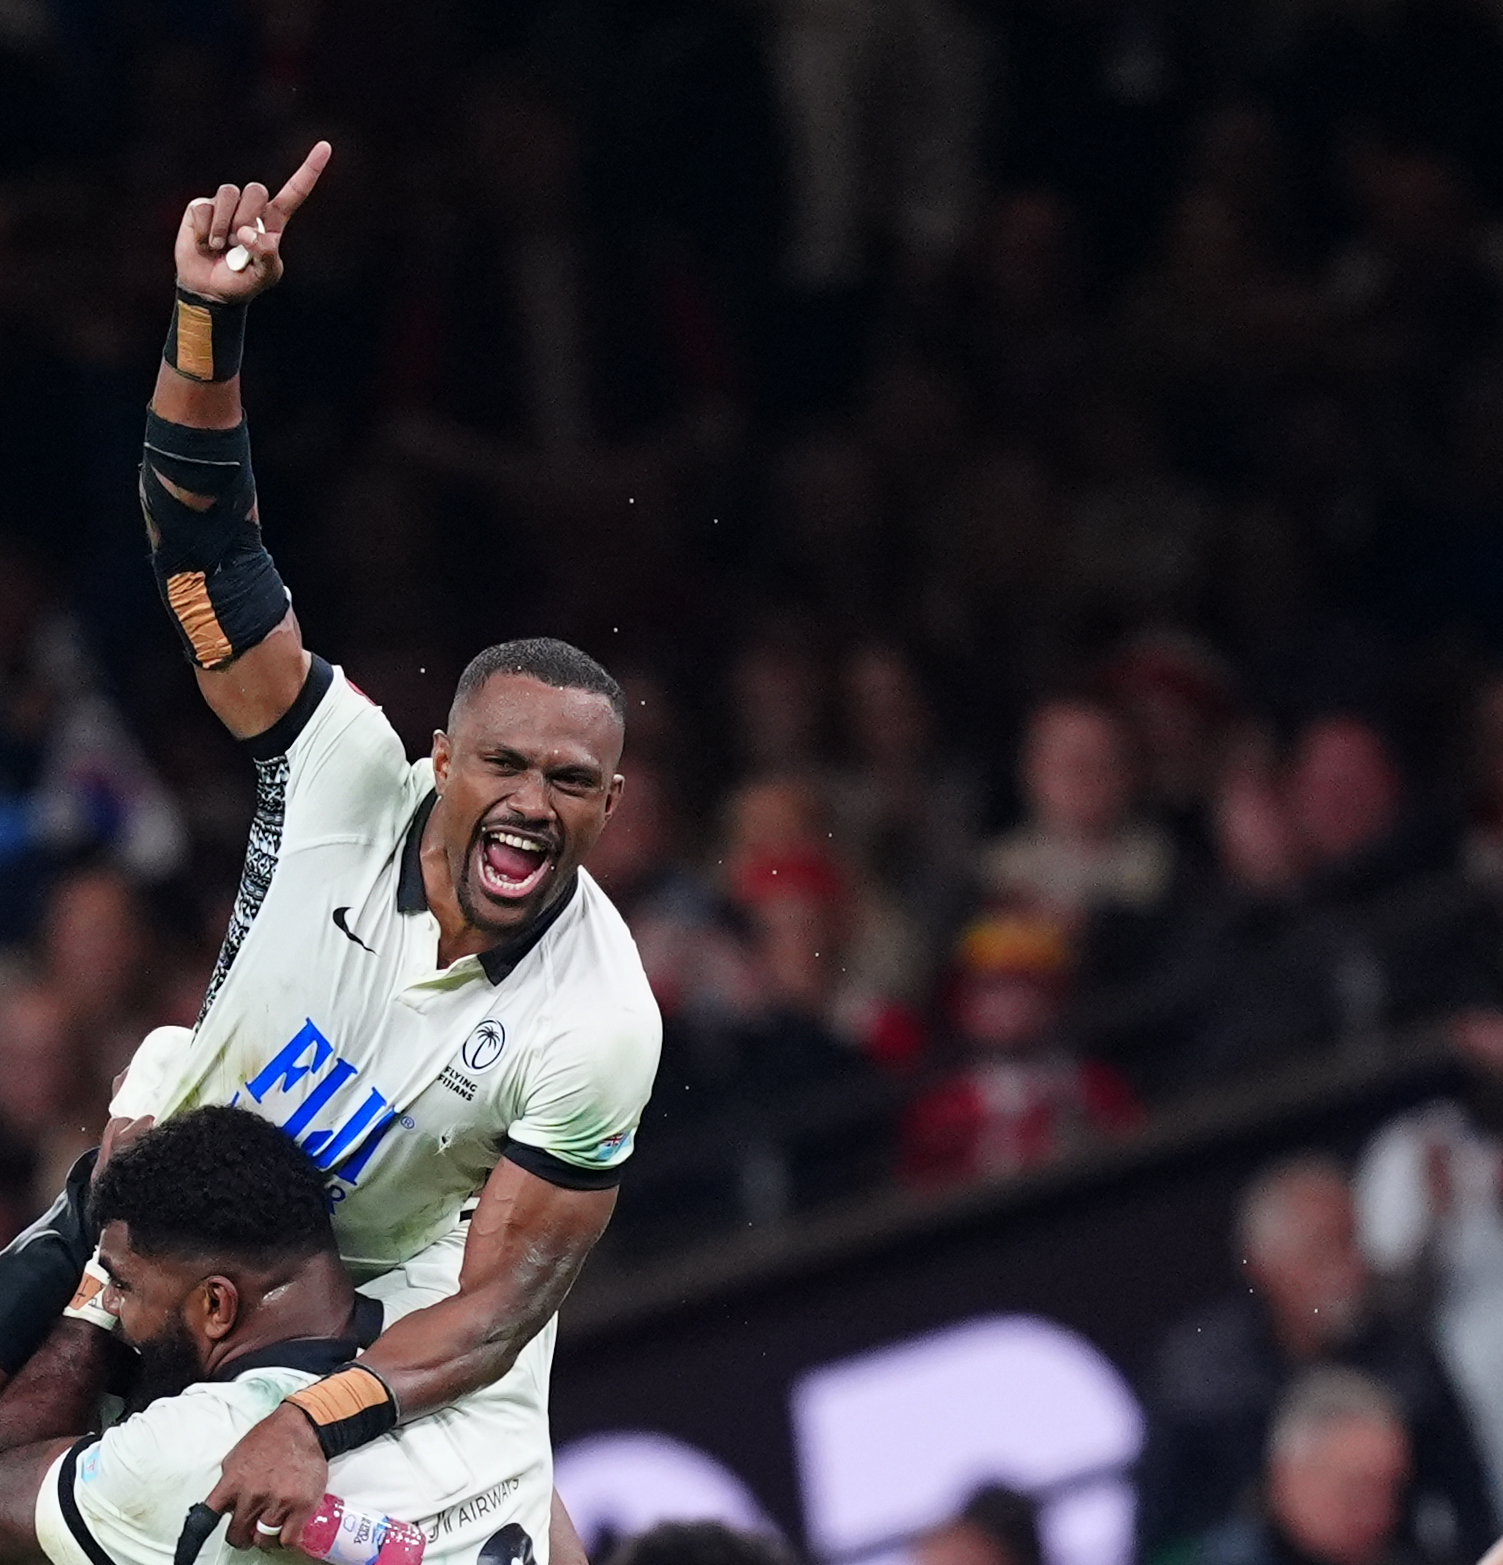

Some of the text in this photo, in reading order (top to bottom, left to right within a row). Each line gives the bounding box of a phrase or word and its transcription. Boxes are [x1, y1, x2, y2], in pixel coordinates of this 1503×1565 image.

[436, 1073, 474, 1102] FIJIANS
[444, 1065, 478, 1092] FLYING
[245, 1017, 395, 1186] FIJI
[458, 1478, 520, 1528] AIRWAYS
